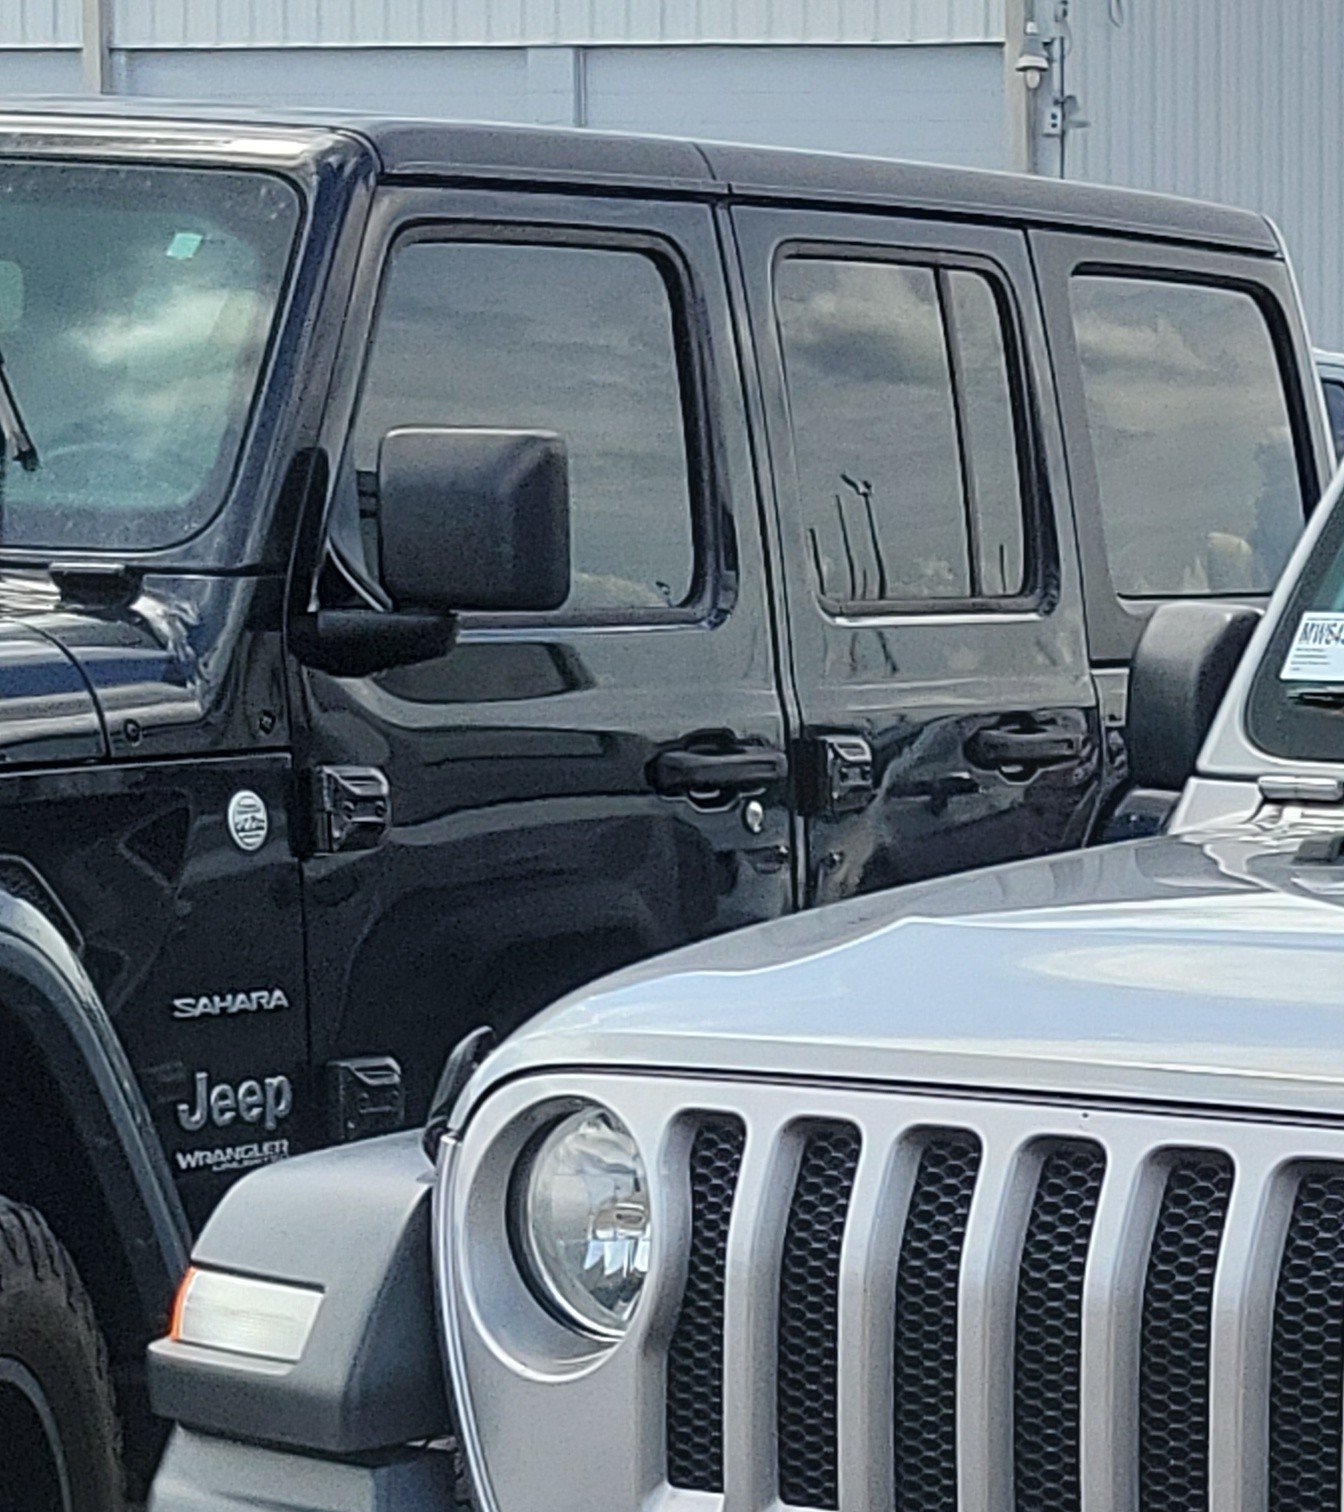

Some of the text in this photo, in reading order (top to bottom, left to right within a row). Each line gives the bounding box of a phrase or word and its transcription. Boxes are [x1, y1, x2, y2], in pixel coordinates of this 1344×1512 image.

[173, 988, 289, 1018] SAHARA
[177, 1071, 293, 1131] Jeep
[176, 1139, 289, 1170] WRANGLER
